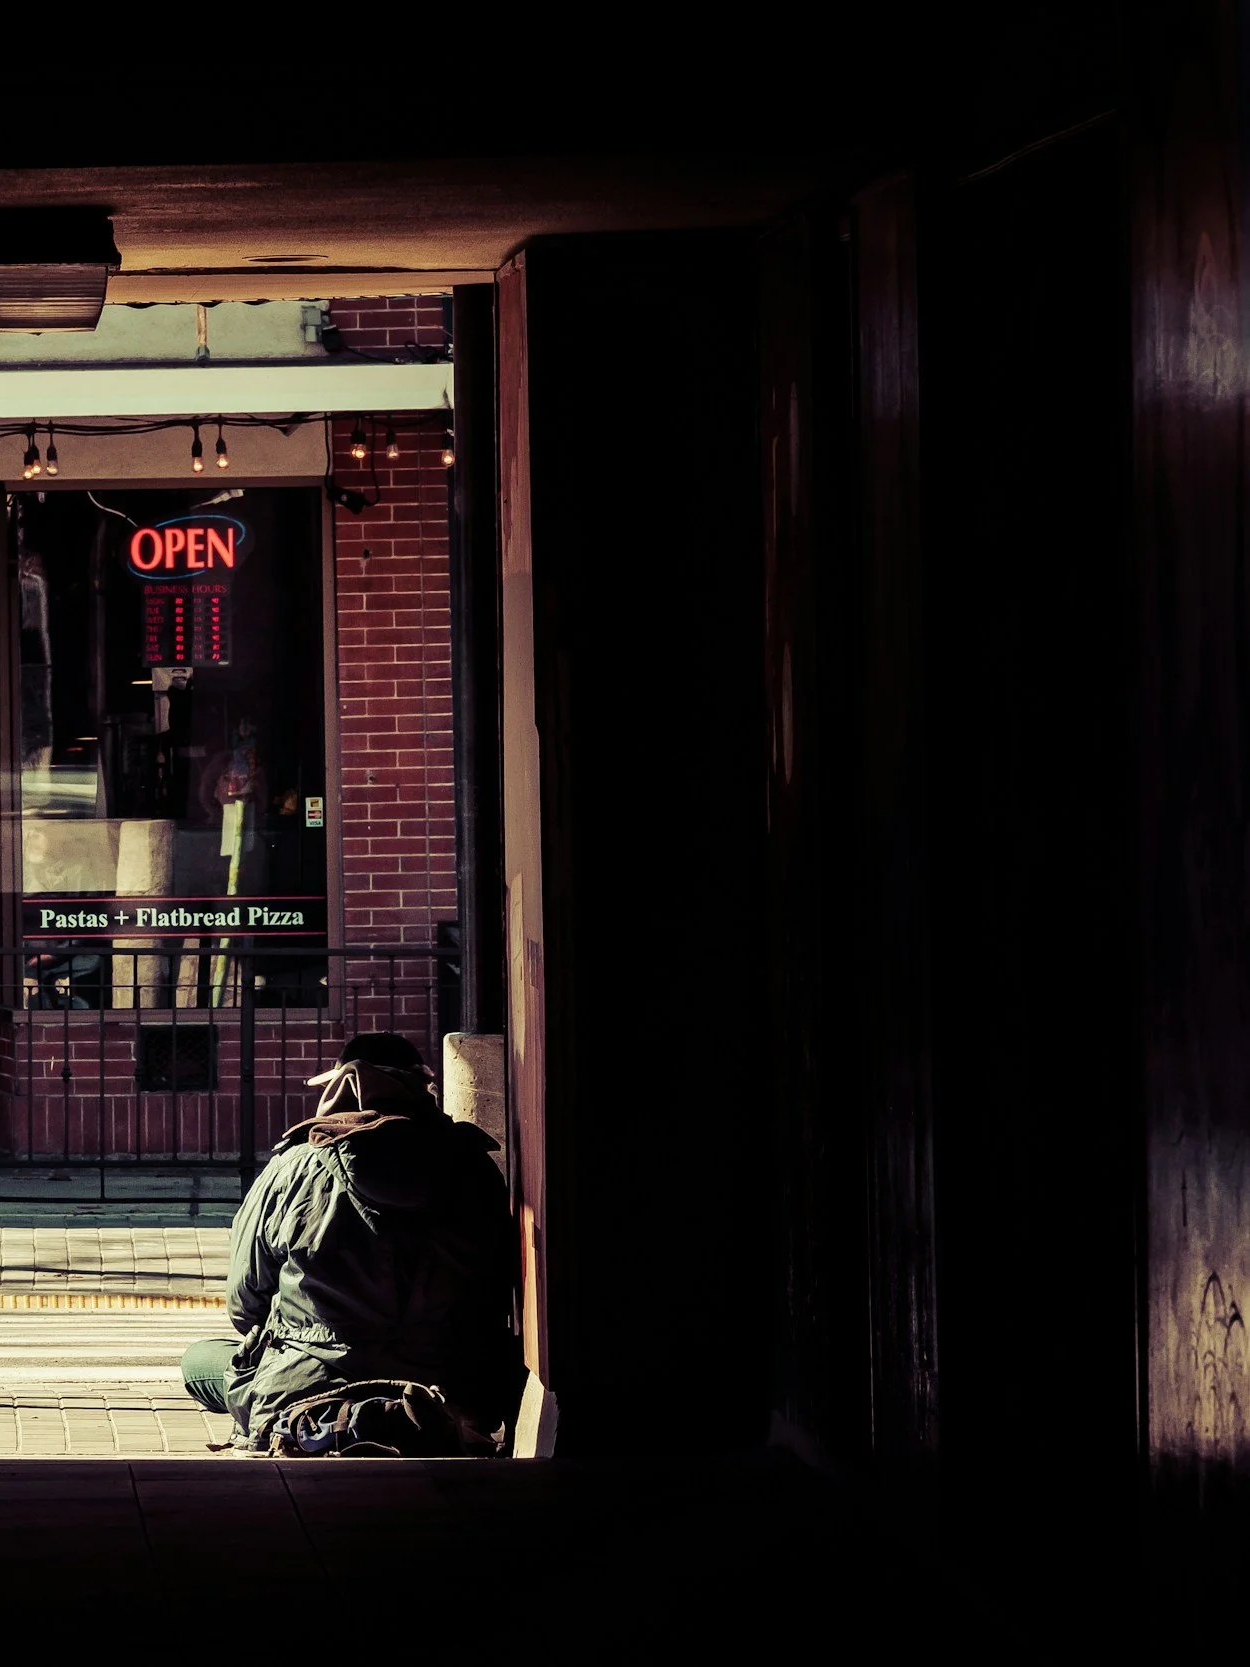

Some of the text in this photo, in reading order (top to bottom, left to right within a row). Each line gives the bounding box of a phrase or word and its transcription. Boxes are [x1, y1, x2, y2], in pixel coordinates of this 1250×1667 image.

[130, 528, 234, 570] OPEN
[144, 585, 227, 594] BUSINESS HOURS
[40, 907, 304, 928] Pastas + Flatbread Pizza
